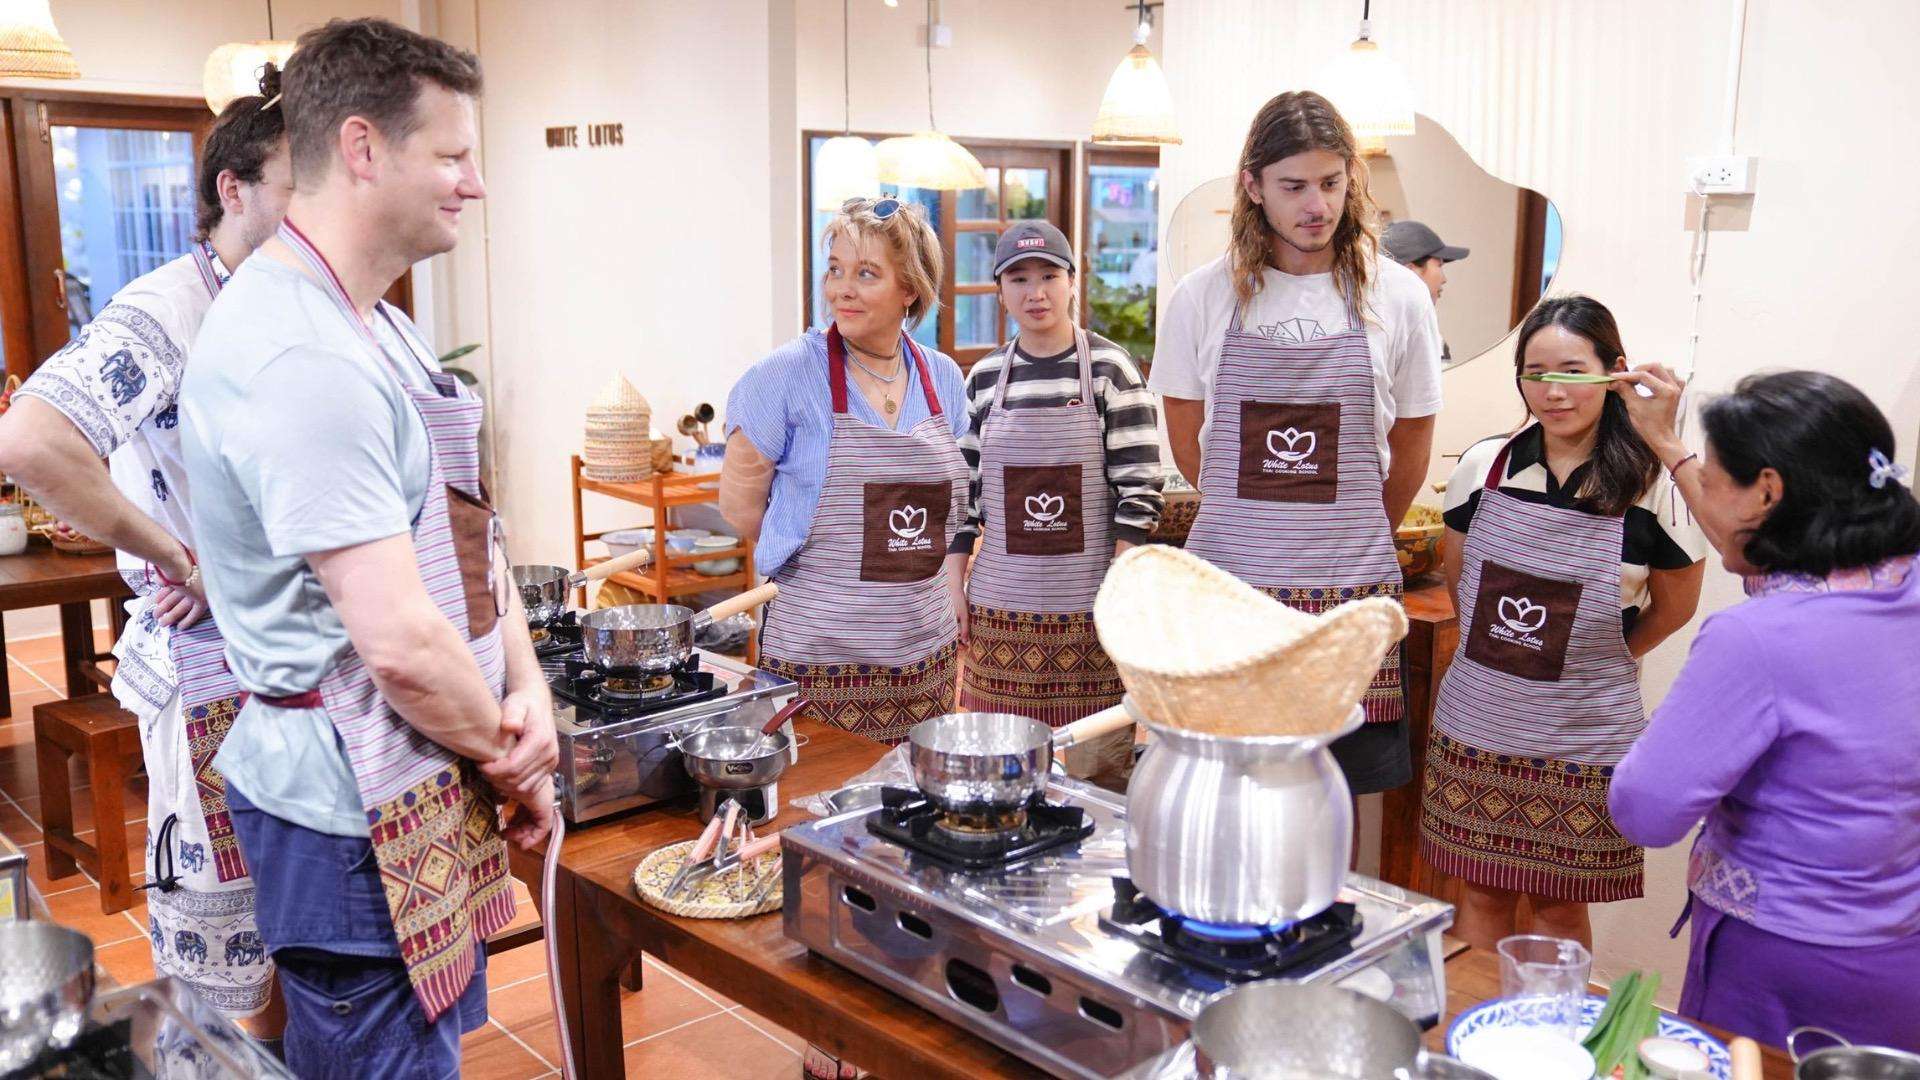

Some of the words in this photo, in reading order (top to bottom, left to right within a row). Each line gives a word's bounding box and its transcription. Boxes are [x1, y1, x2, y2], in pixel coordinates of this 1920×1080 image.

[546, 126, 577, 148] WHITE
[588, 122, 624, 146] LOTUS
[1263, 459, 1288, 469] White
[1293, 460, 1318, 470] Lotus
[1046, 519, 1067, 527] Lotus
[888, 538, 908, 547] White
[912, 536, 931, 545] Lotus
[1490, 624, 1515, 637] White
[1518, 633, 1543, 646] Lotus
